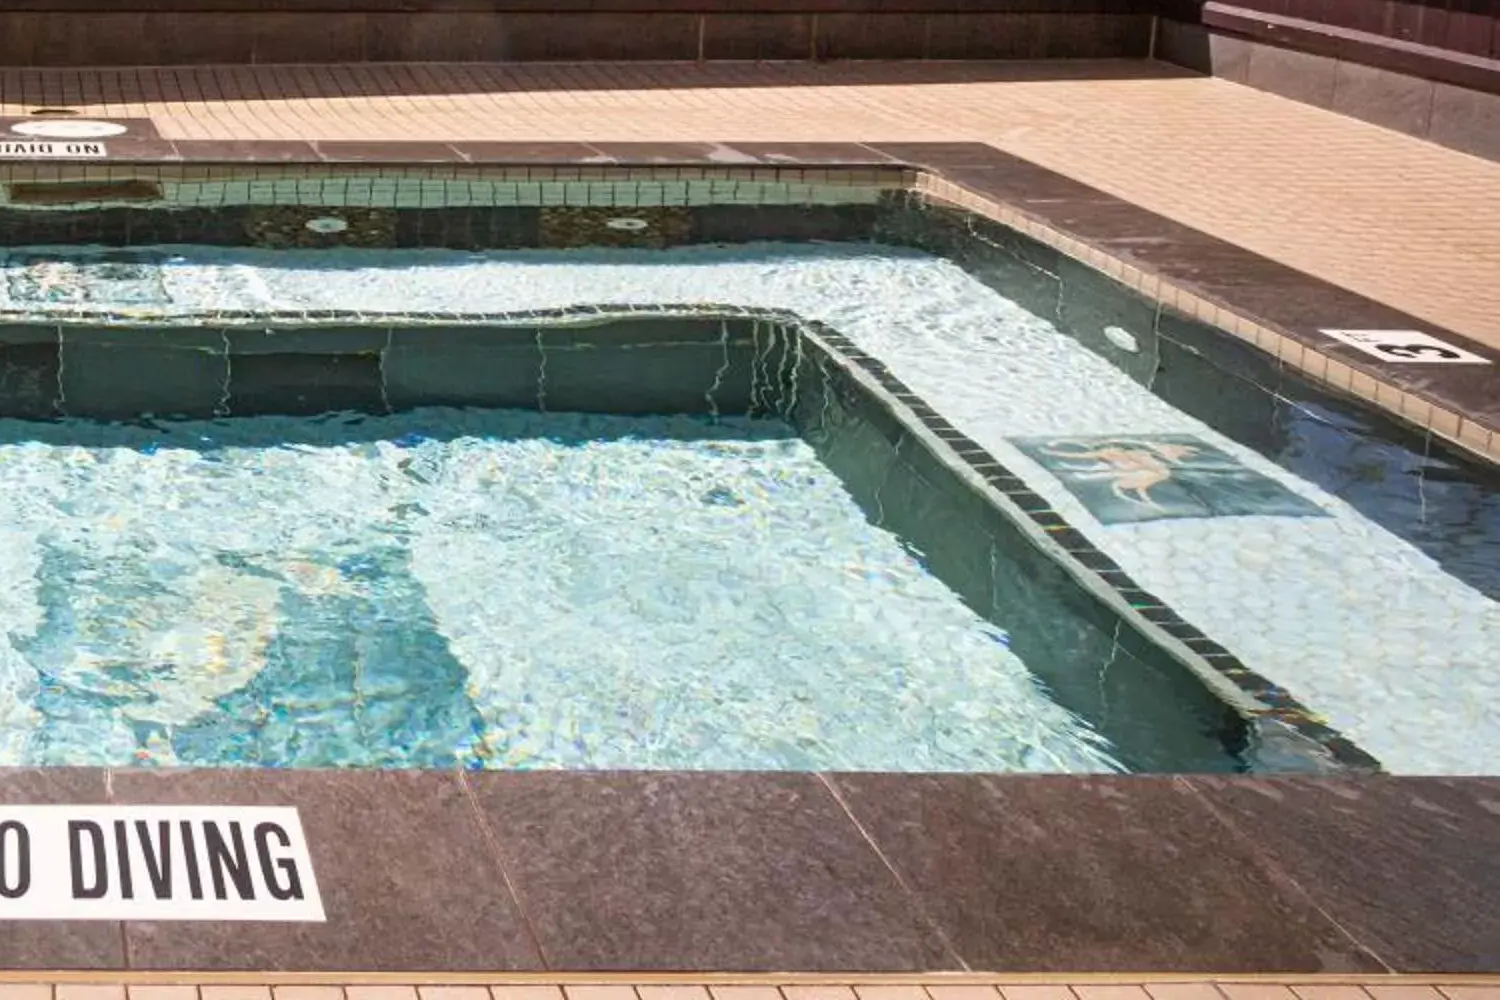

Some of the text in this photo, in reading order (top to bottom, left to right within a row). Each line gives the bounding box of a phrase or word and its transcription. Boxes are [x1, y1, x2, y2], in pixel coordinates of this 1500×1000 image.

[66, 143, 100, 155] NO
[1374, 344, 1460, 359] 3
[68, 819, 304, 900] DIVING
